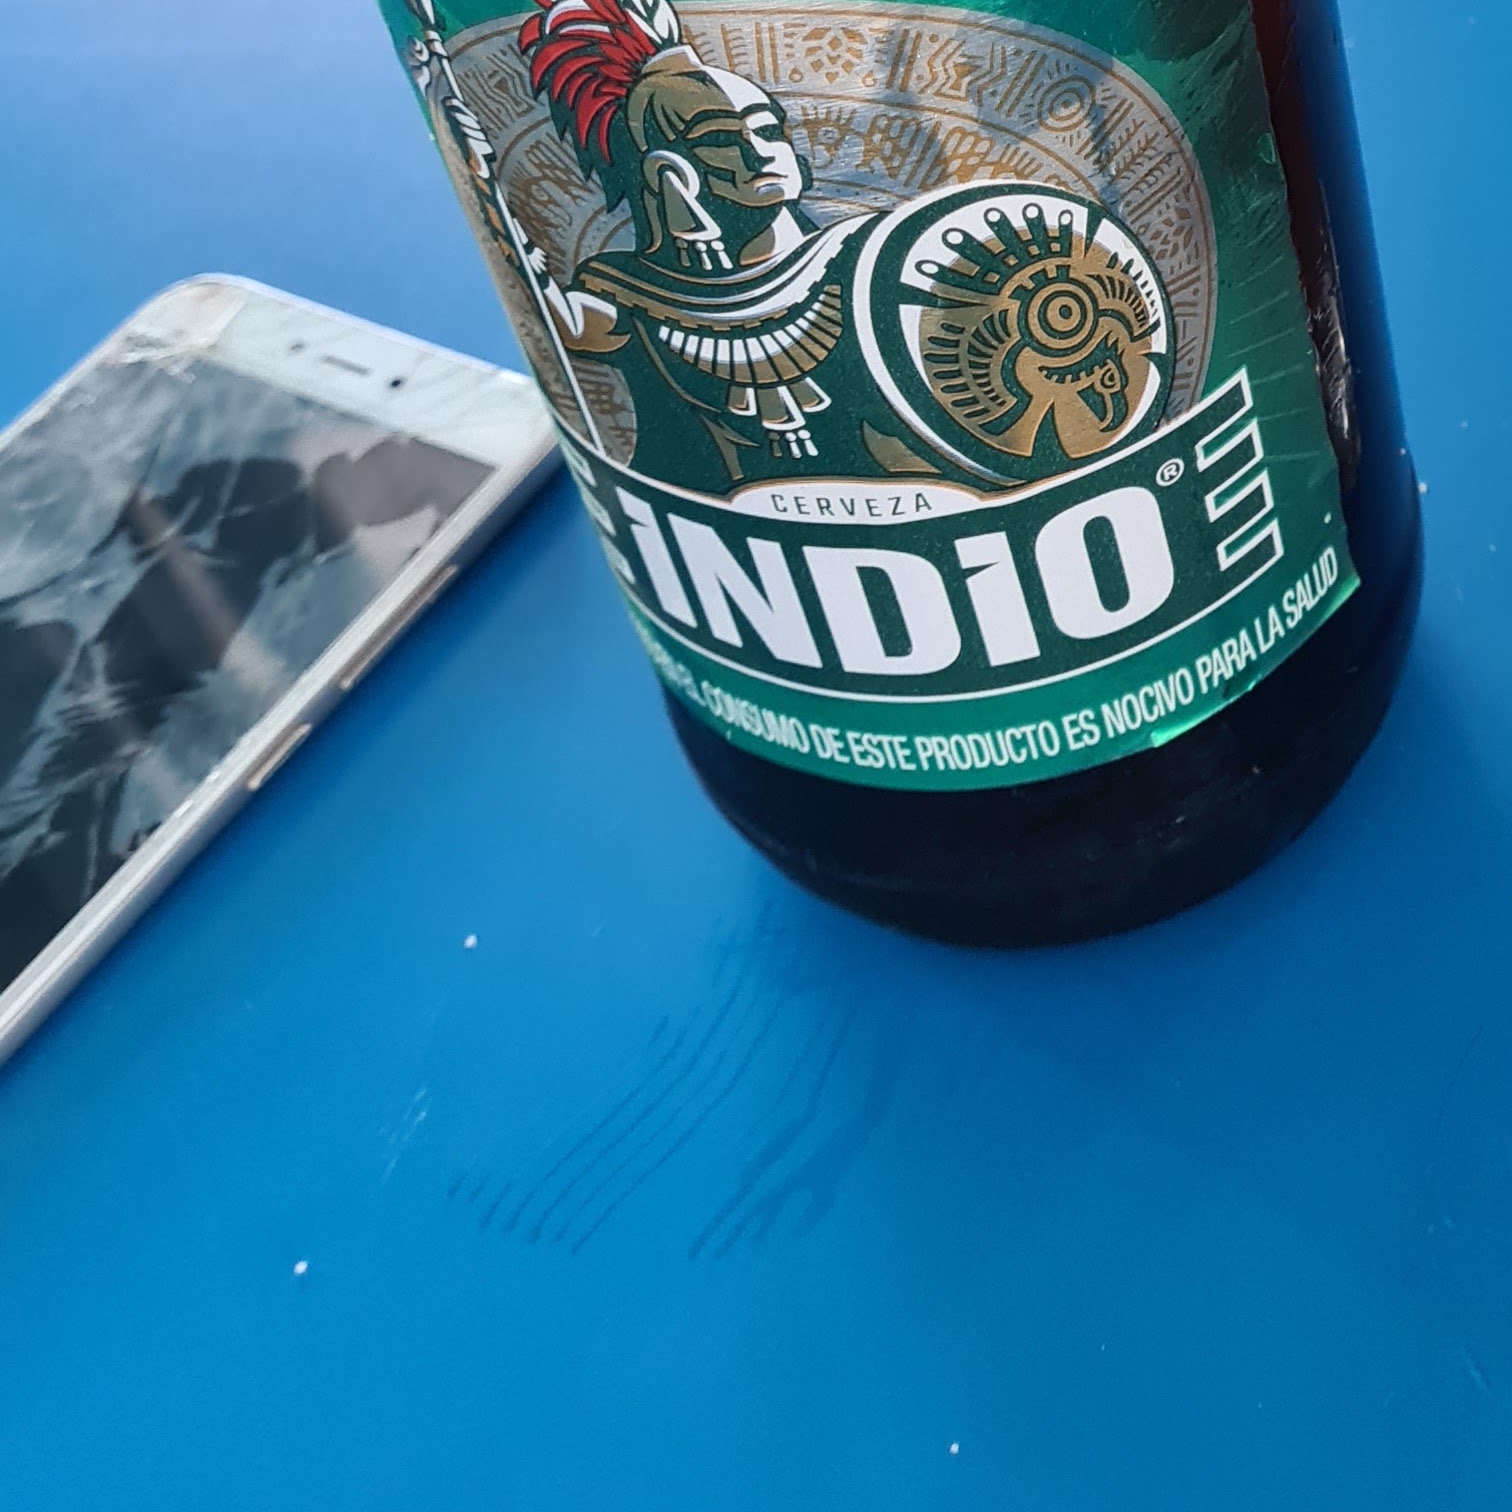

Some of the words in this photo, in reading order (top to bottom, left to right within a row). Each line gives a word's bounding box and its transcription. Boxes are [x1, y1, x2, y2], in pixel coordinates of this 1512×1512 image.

[614, 485, 1176, 676] INDIO
[770, 491, 934, 518] CERVEZA
[808, 722, 851, 764] DE
[846, 730, 917, 771] ESTE
[914, 720, 1061, 771] PRODUCTO
[1061, 708, 1101, 752] ES
[1100, 666, 1195, 739] NOCIVO
[1194, 626, 1258, 695] PARA
[1253, 604, 1286, 655] LA
[1281, 545, 1339, 630] SALUD
